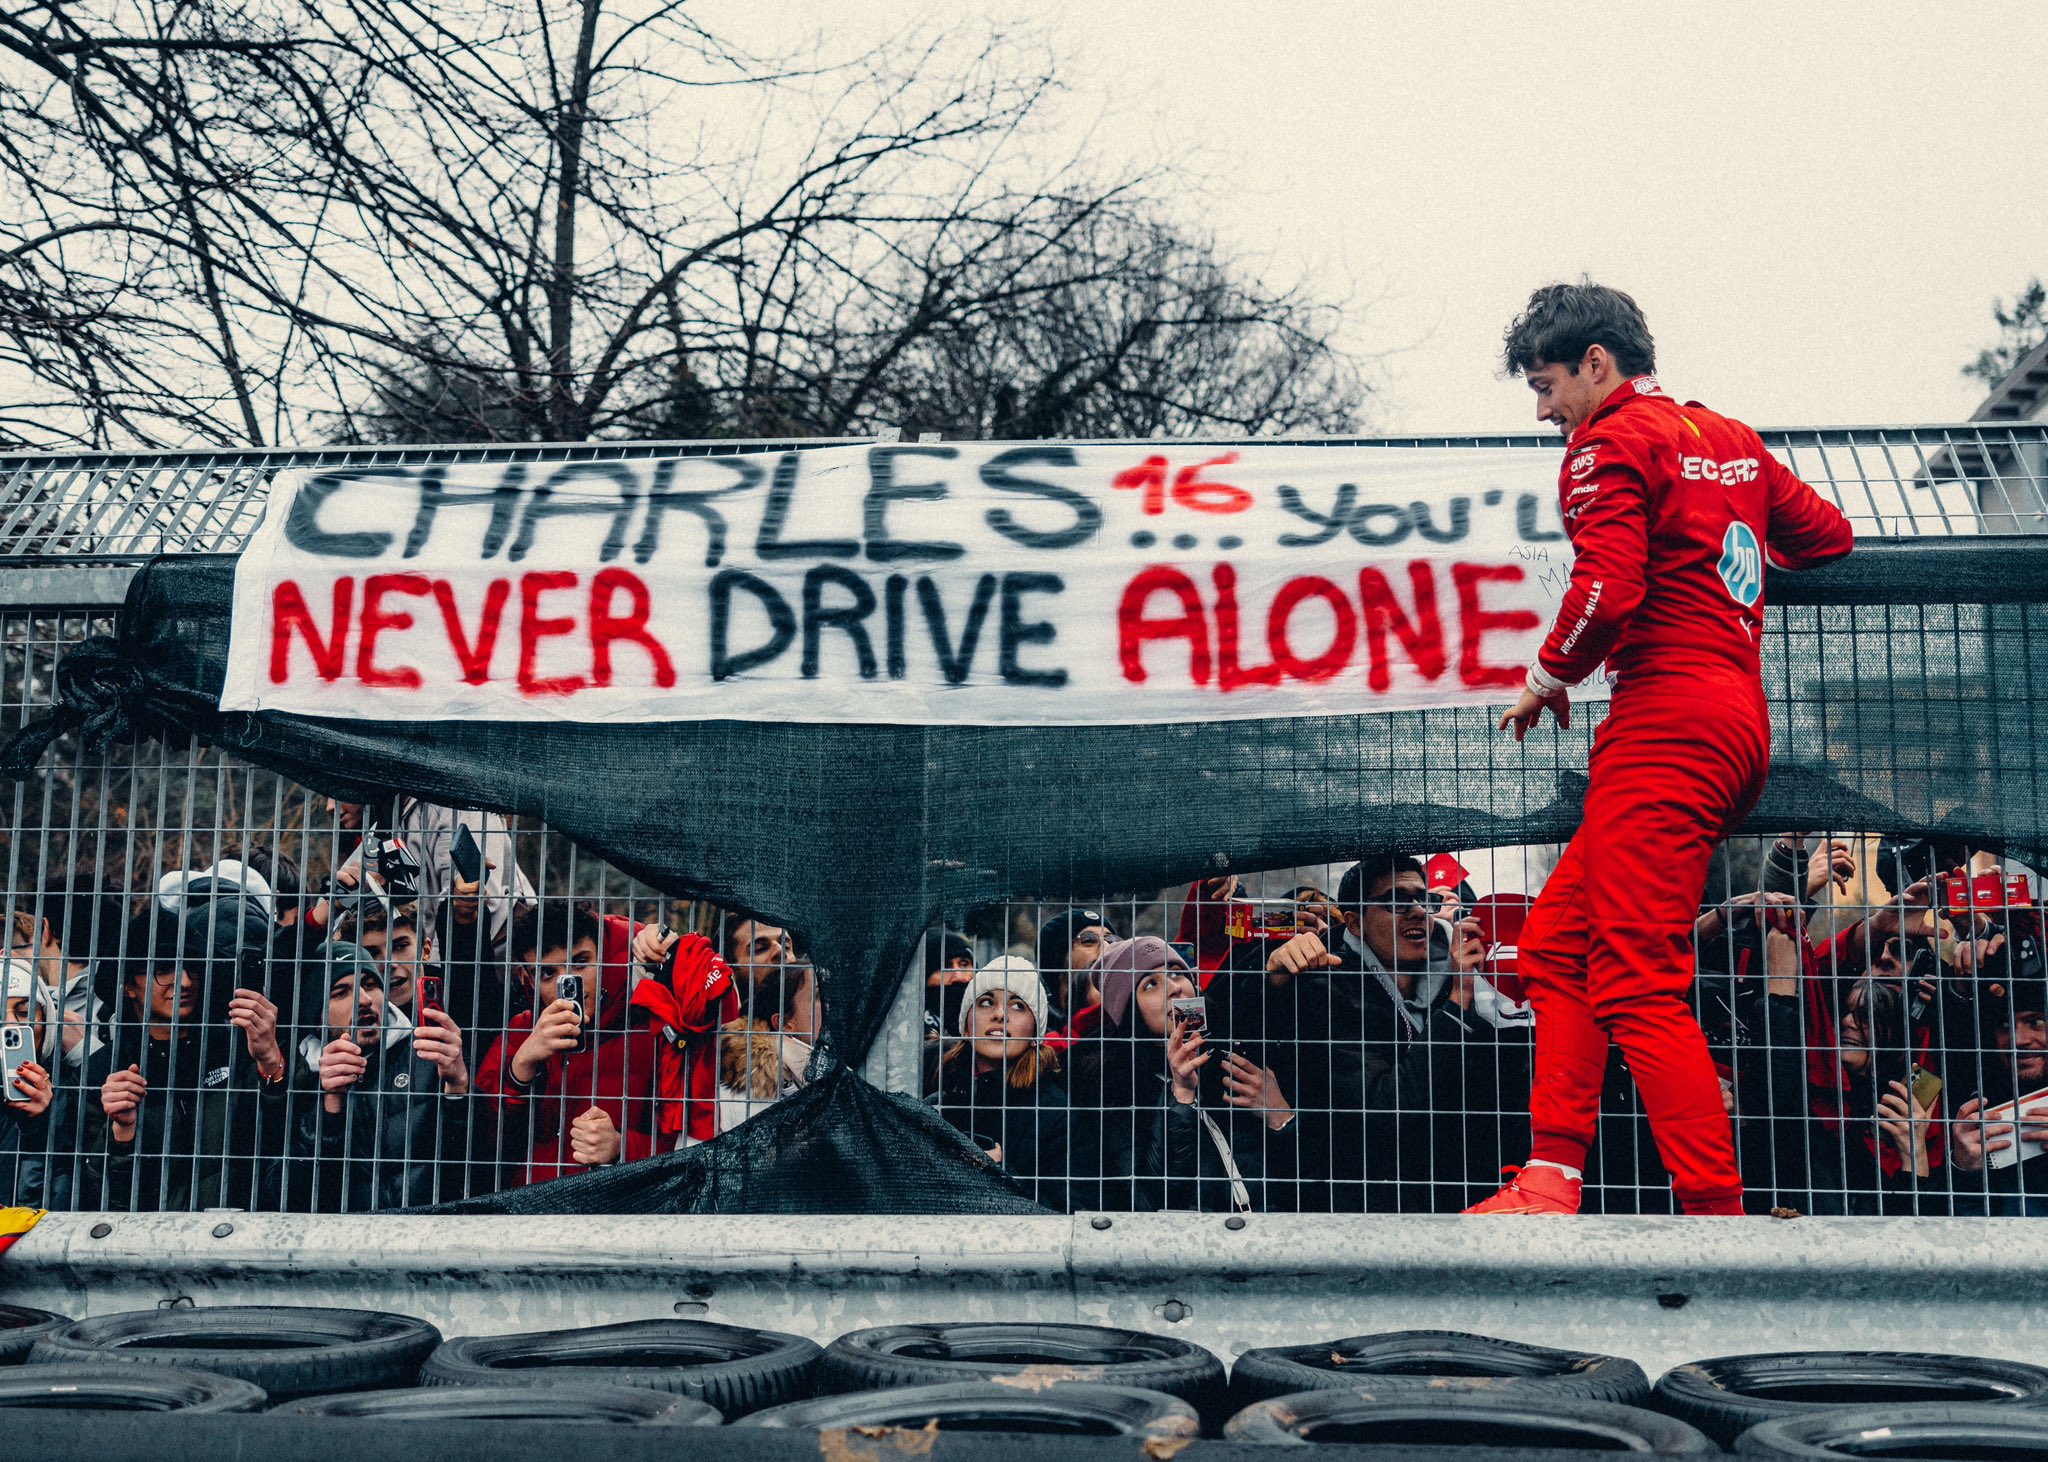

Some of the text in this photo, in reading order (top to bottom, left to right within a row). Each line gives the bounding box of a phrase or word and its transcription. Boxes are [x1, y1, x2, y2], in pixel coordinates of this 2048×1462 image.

[1571, 454, 1596, 472] aws
[284, 447, 1103, 567] CHARLES
[1111, 452, 1254, 515] 16
[1508, 544, 1548, 562] ASIA
[268, 561, 1540, 697] NEVER DRIVE ALONE
[1560, 580, 1603, 654] RICHARD MILLE
